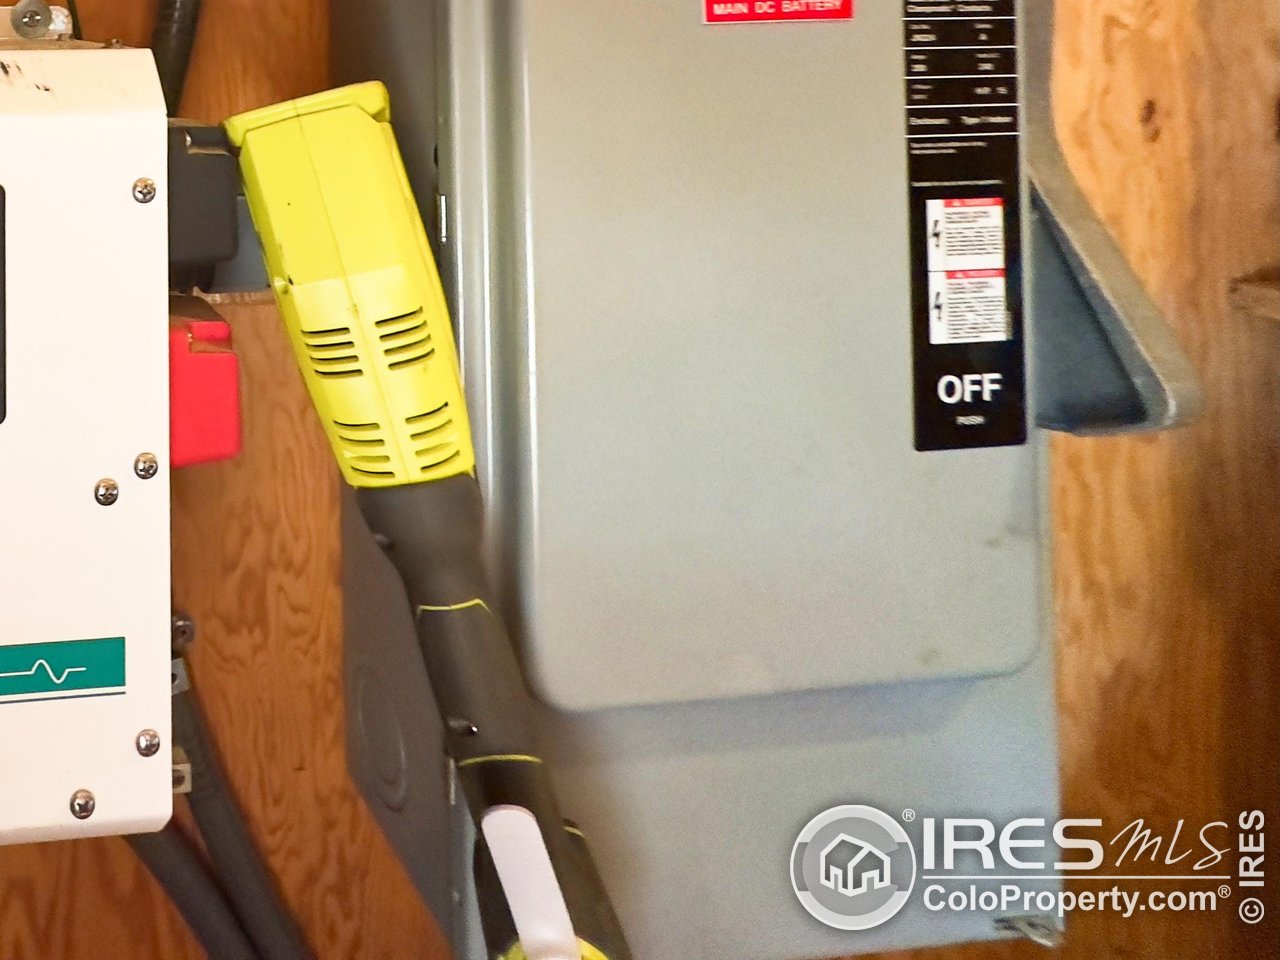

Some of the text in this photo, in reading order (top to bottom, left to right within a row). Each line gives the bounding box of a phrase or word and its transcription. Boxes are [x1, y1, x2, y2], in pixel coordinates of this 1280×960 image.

[713, 2, 749, 15] MAIN
[754, 1, 776, 14] DC
[937, 372, 1003, 404] OFF
